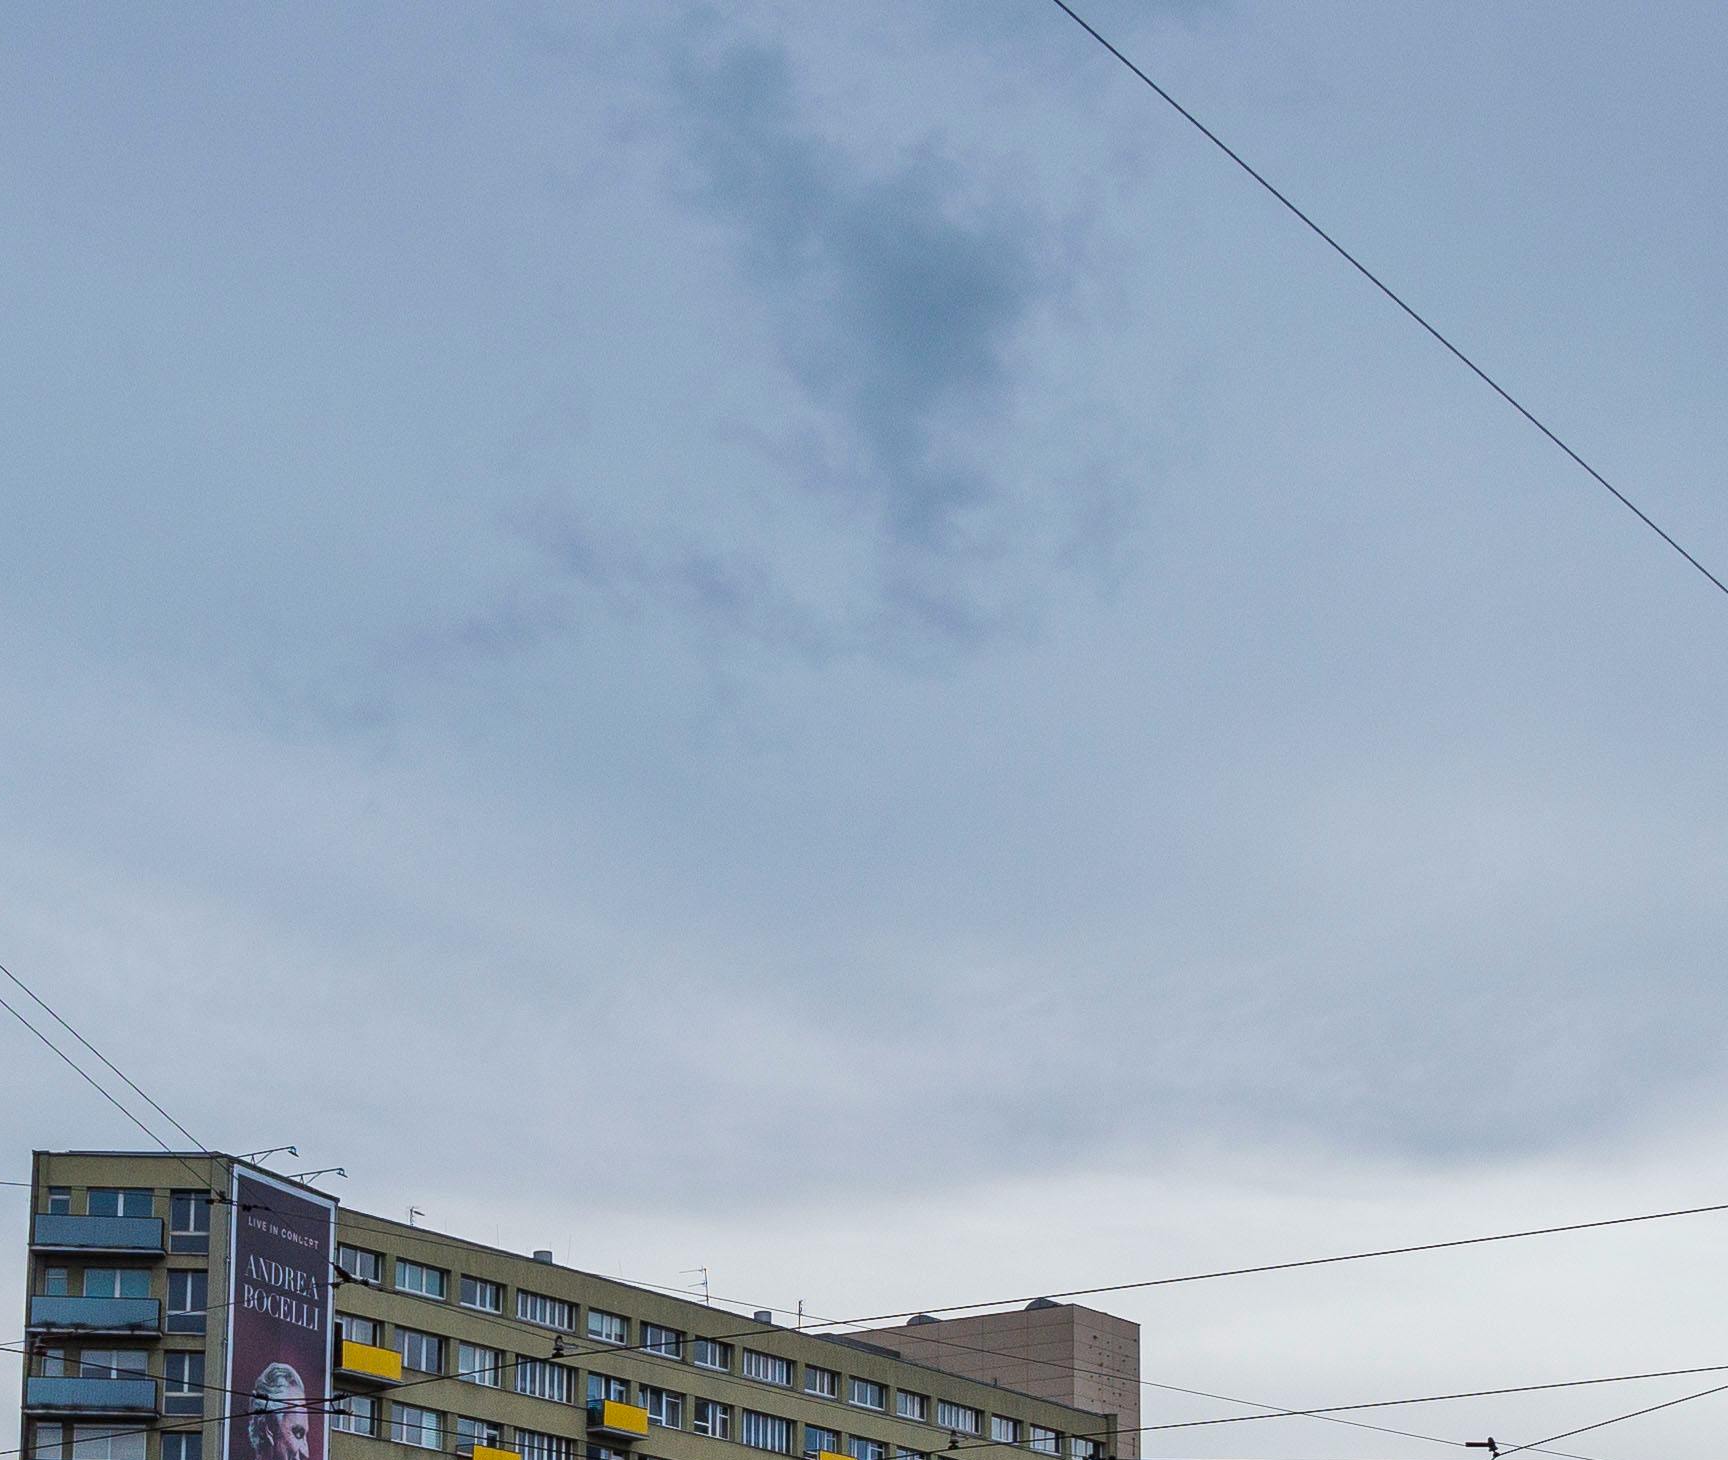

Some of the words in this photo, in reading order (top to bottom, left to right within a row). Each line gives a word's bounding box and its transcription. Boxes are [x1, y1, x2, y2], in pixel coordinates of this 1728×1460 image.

[248, 1216, 267, 1231] LIVE
[269, 1224, 279, 1236] IN
[244, 1253, 320, 1301] ANDREA
[242, 1282, 320, 1332] BOCELLI
